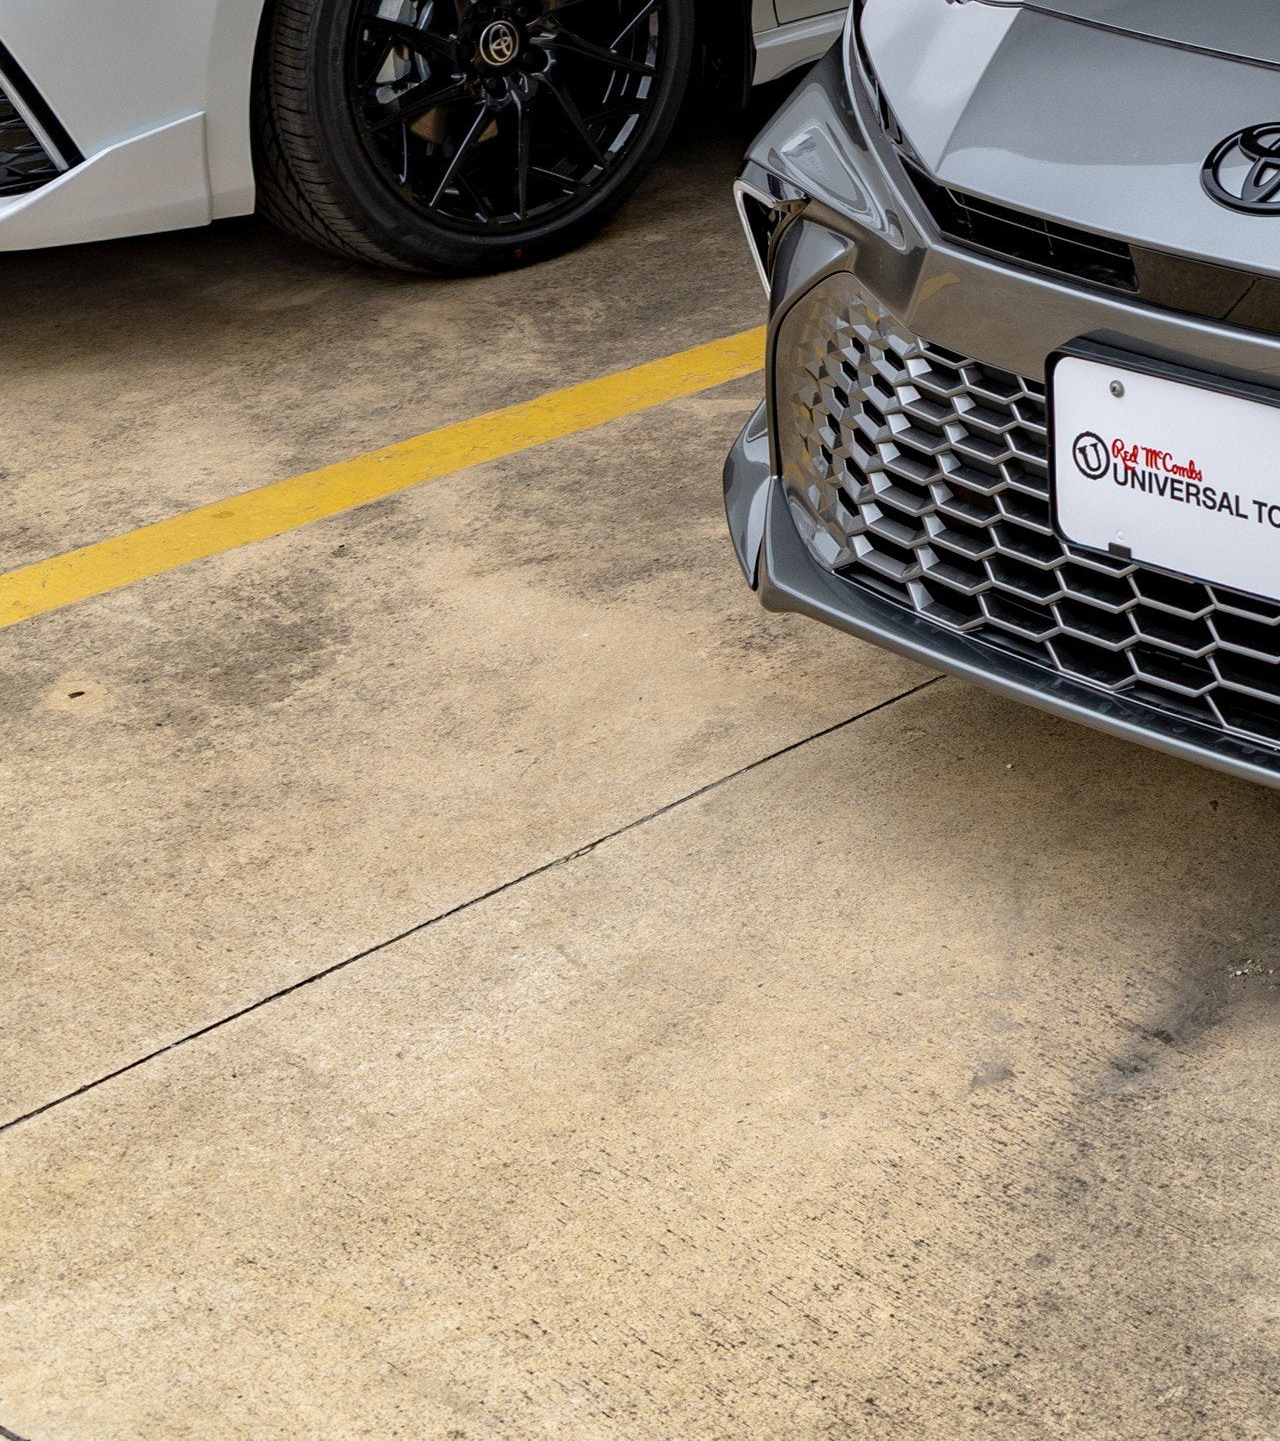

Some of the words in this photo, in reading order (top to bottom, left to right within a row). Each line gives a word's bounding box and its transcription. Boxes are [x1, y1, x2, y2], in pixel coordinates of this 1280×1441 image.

[1111, 438, 1139, 471] Red
[1140, 445, 1203, 482] McCombs
[1112, 462, 1249, 520] UNIVERSAL
